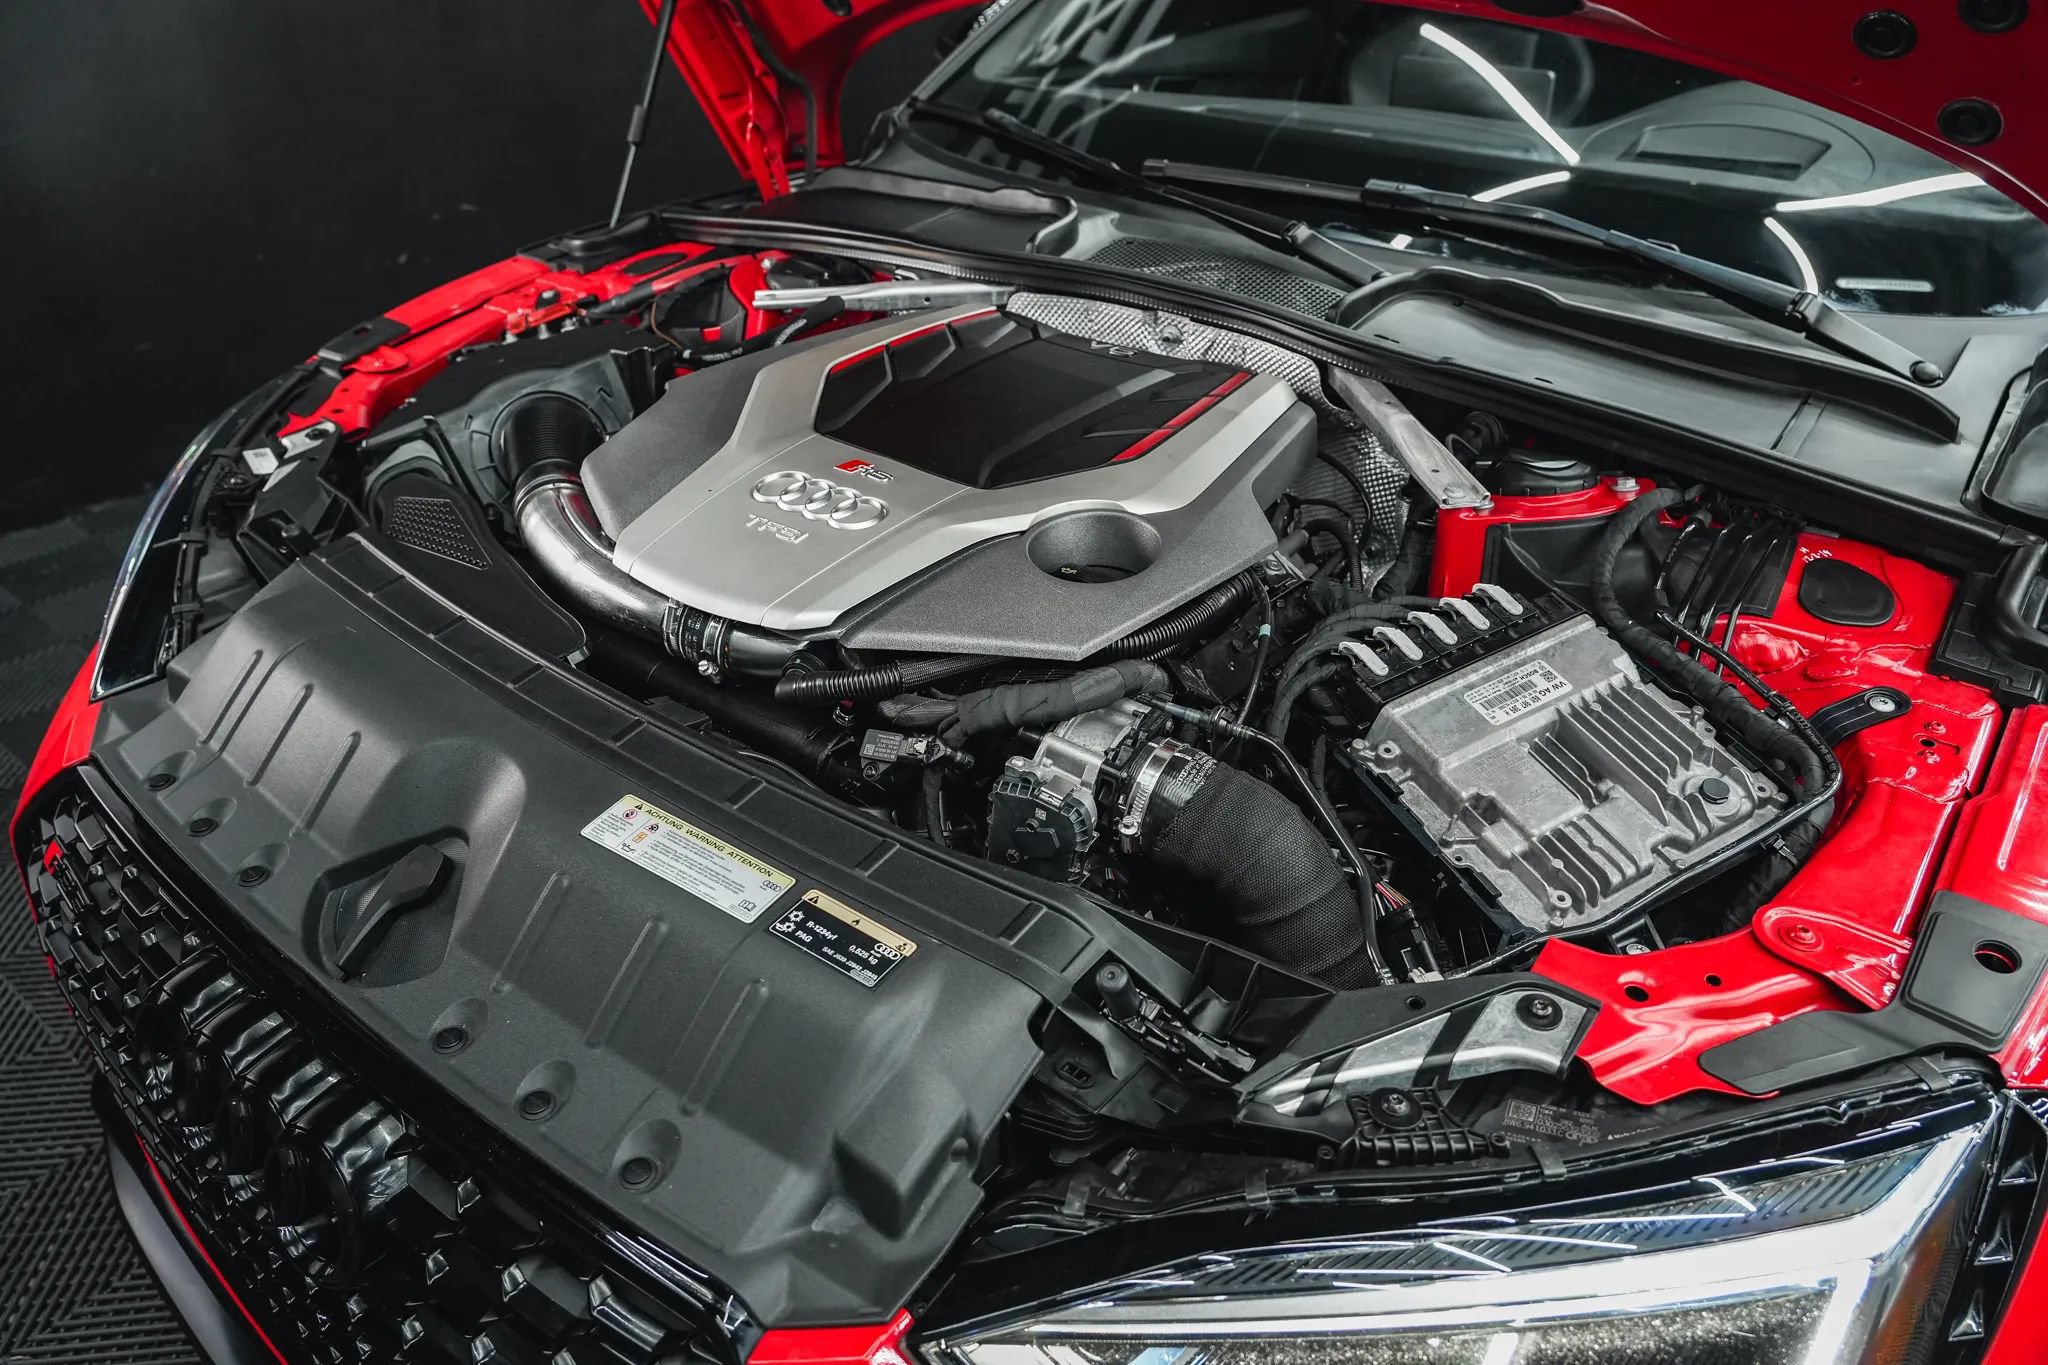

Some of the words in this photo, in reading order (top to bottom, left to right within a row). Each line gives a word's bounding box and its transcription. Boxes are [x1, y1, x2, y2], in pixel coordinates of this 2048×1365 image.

[745, 513, 809, 545] TFSI
[1520, 669, 1539, 681] BOSCH
[1551, 680, 1567, 690] VW
[1538, 686, 1551, 696] AG
[643, 808, 684, 830] ACHTUNG
[683, 828, 726, 852] WARNING
[725, 850, 774, 877] ATTENTION
[794, 929, 813, 943] PAG
[821, 945, 835, 955] SAE
[804, 920, 838, 941] R-1234yf
[865, 955, 880, 965] kg
